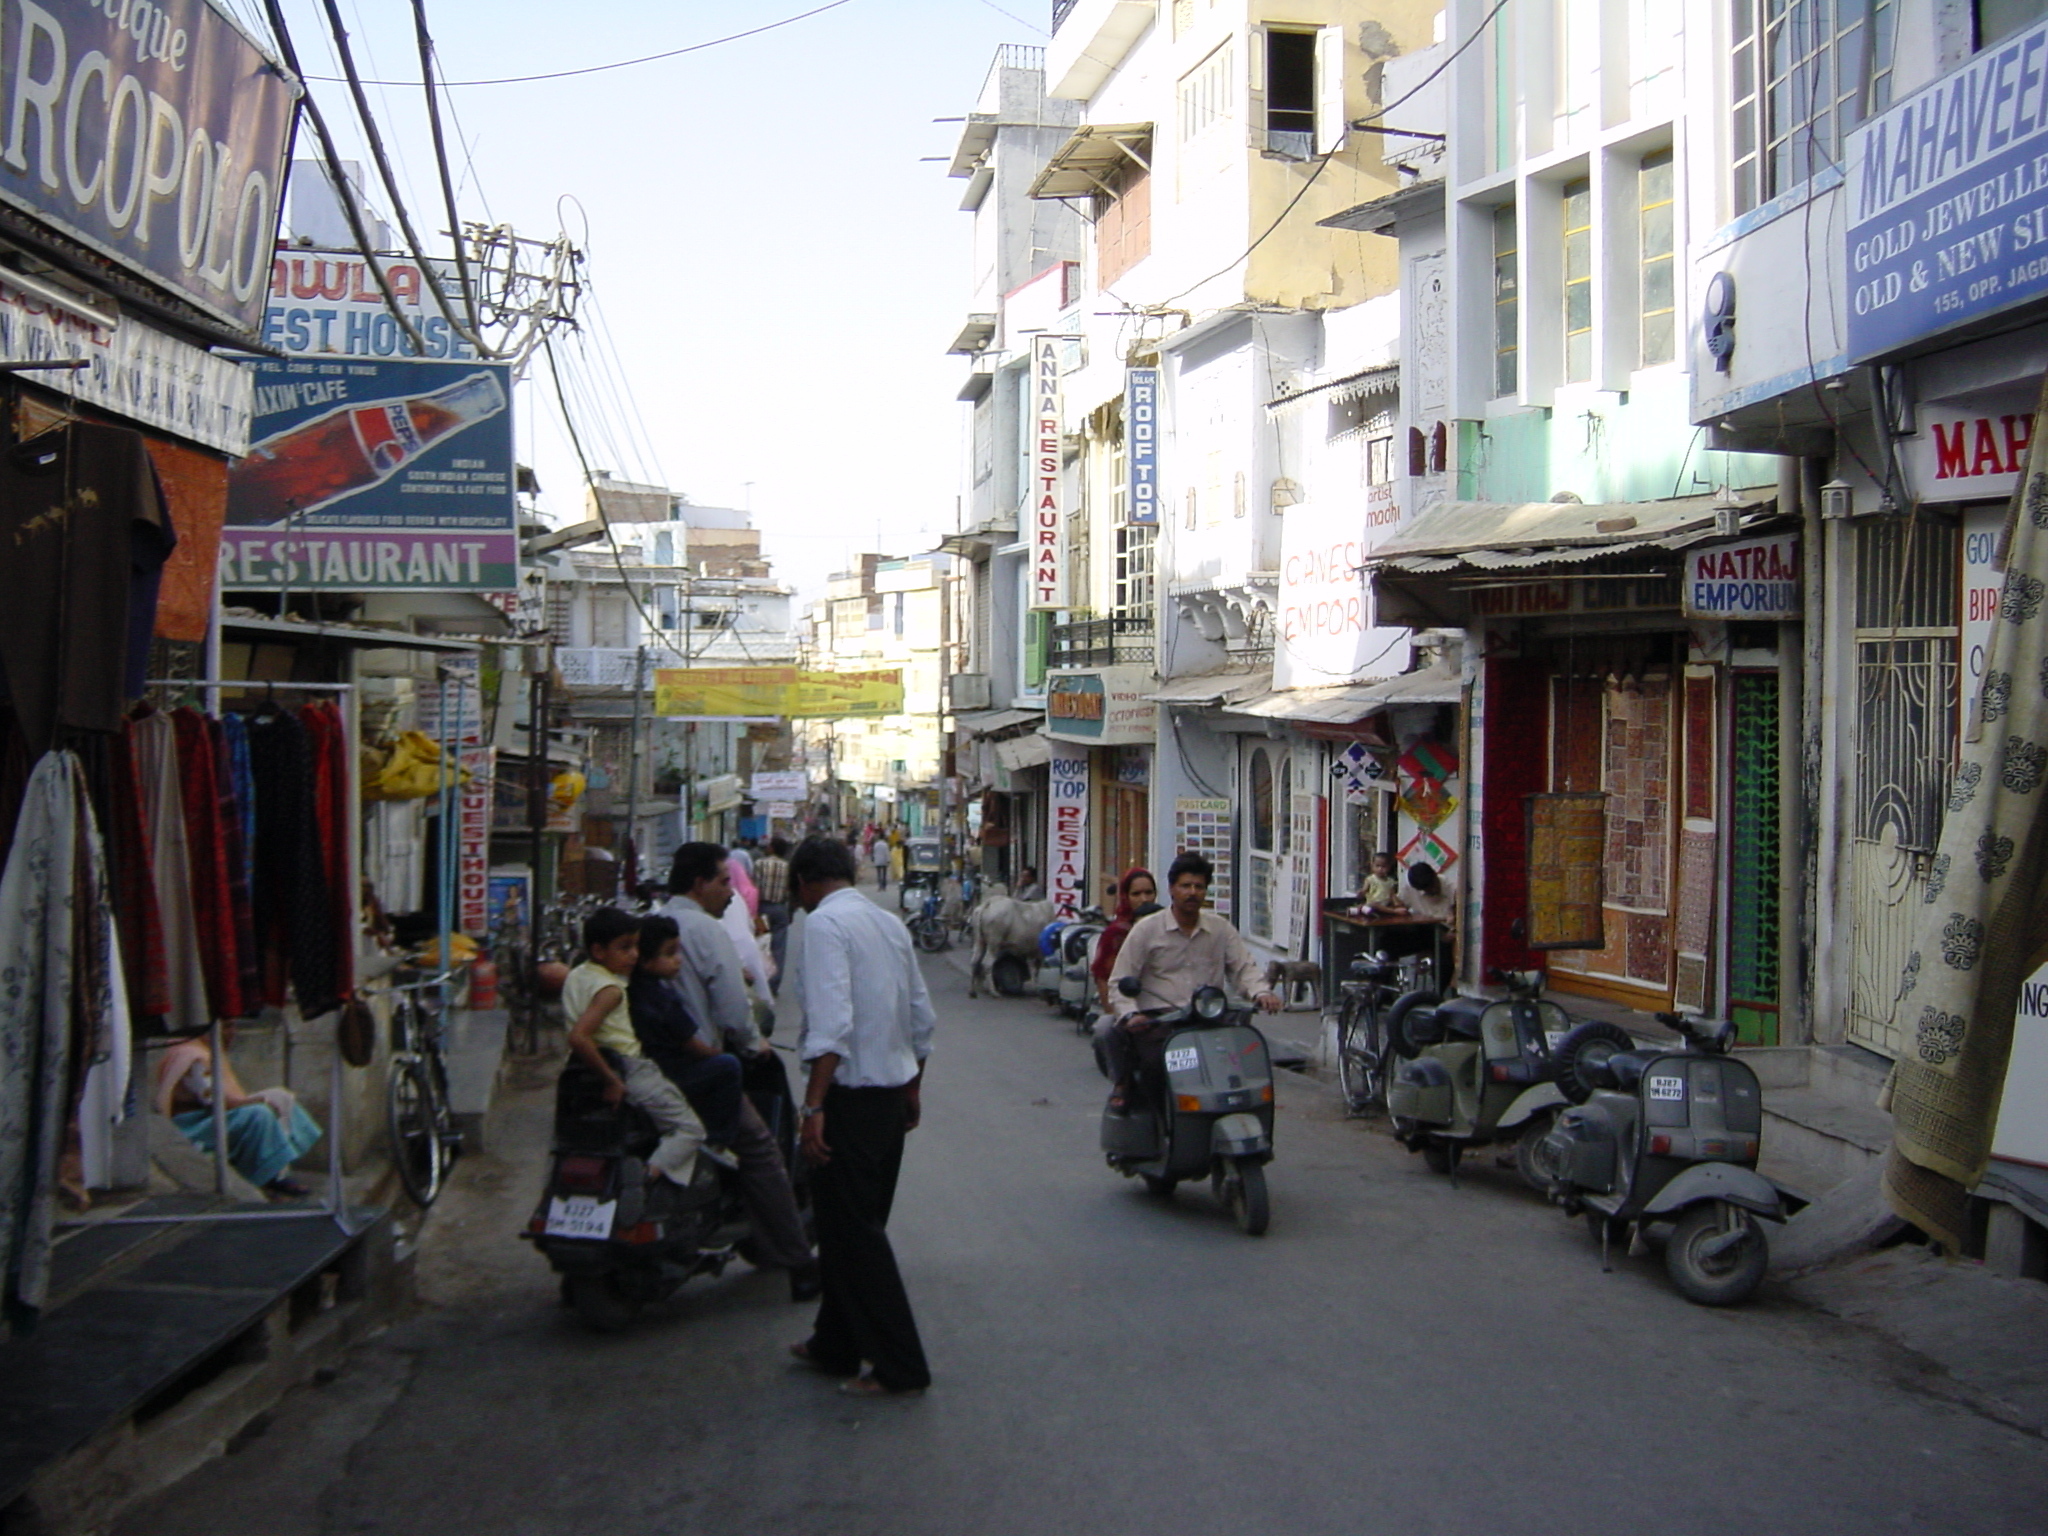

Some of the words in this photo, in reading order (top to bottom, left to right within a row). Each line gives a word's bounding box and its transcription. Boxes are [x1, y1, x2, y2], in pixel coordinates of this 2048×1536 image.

[0, 0, 268, 303] RCOPOLO
[1854, 218, 1916, 272] GOLD
[1855, 271, 1901, 316] OLD
[1909, 260, 1930, 293] &
[1936, 222, 2006, 283] NEW
[2013, 204, 2048, 251] SI
[1934, 289, 1965, 315] 155,
[1969, 274, 2003, 302] OPP.
[345, 311, 475, 360] HOUSE
[302, 380, 349, 406] CAFE
[1040, 343, 1058, 413] ANNA
[1135, 387, 1153, 460] ROOF
[1037, 419, 1058, 602] RESTAURANT
[1135, 464, 1153, 519] TOP
[219, 541, 487, 584] RESTAURANT
[1697, 541, 1801, 580] NATRAJ
[1969, 586, 2002, 622] BIR
[1053, 758, 1089, 776] ROOF
[1054, 780, 1086, 798] TOP
[462, 858, 485, 931] HOUSE
